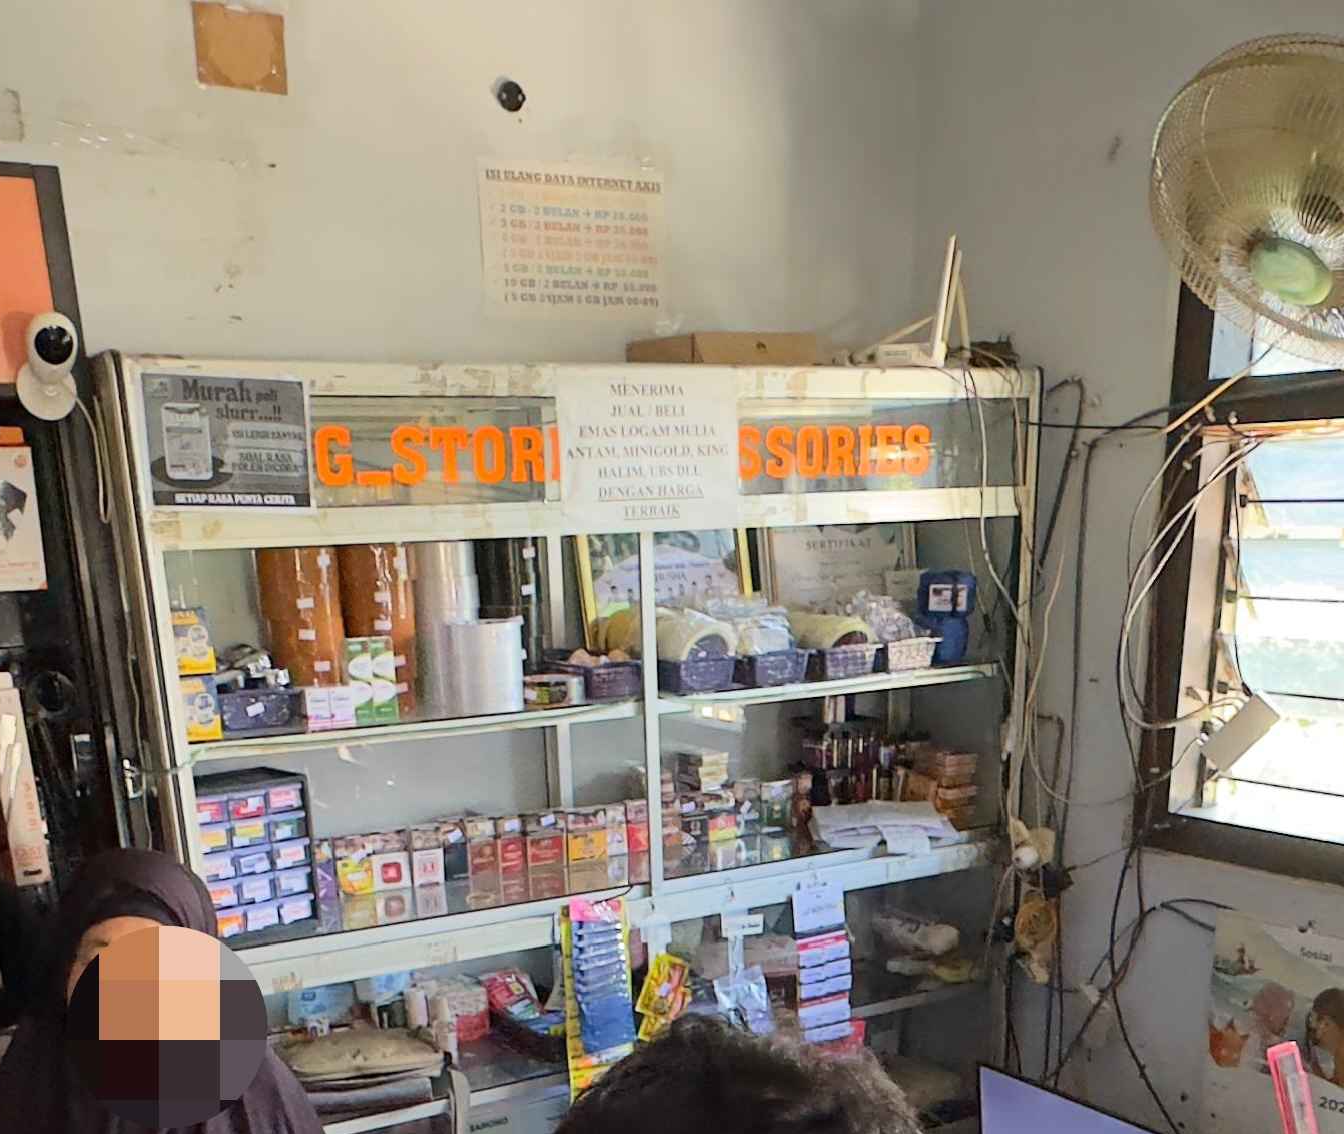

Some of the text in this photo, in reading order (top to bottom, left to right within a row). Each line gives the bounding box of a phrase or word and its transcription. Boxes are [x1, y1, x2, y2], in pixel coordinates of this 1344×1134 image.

[182, 379, 253, 402] Murah
[609, 384, 684, 396] MENERIMA
[610, 405, 643, 417] JUAL
[655, 405, 685, 417] BELI
[579, 424, 716, 438] EMAS LOGAM MULIA
[697, 443, 728, 456] KING
[599, 484, 704, 500] DENGAN HARGA
[623, 504, 680, 518] TERBAIK
[1299, 947, 1333, 964] Sosial
